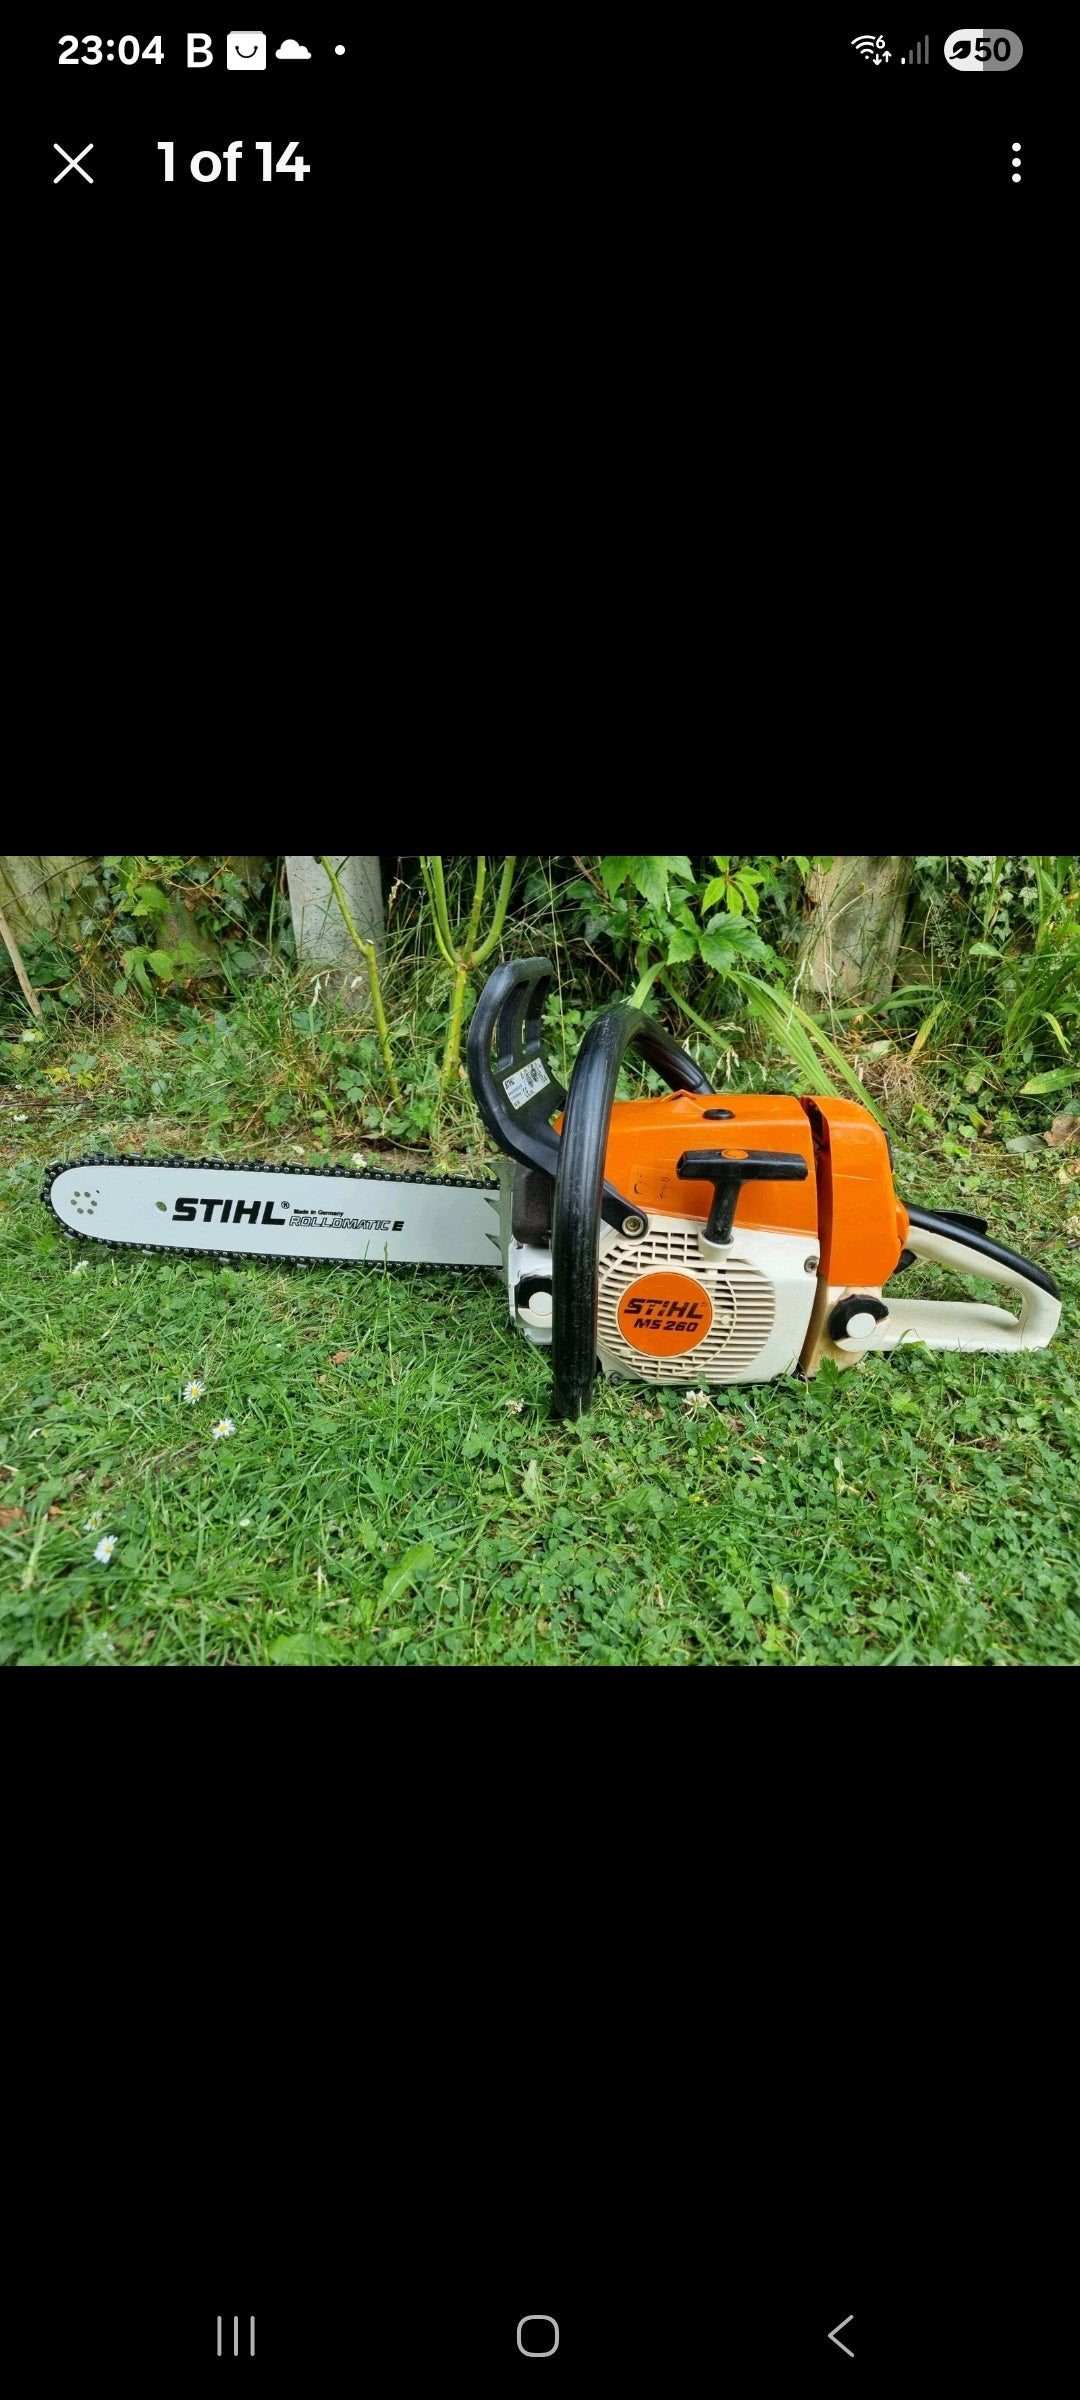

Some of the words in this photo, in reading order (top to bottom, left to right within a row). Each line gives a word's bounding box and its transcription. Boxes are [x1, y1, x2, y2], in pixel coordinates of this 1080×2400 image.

[318, 1209, 344, 1218] Germany
[288, 1215, 391, 1231] ROLLOMATIC
[391, 1220, 405, 1232] E
[633, 1317, 662, 1330] MS
[662, 1320, 699, 1333] 260
